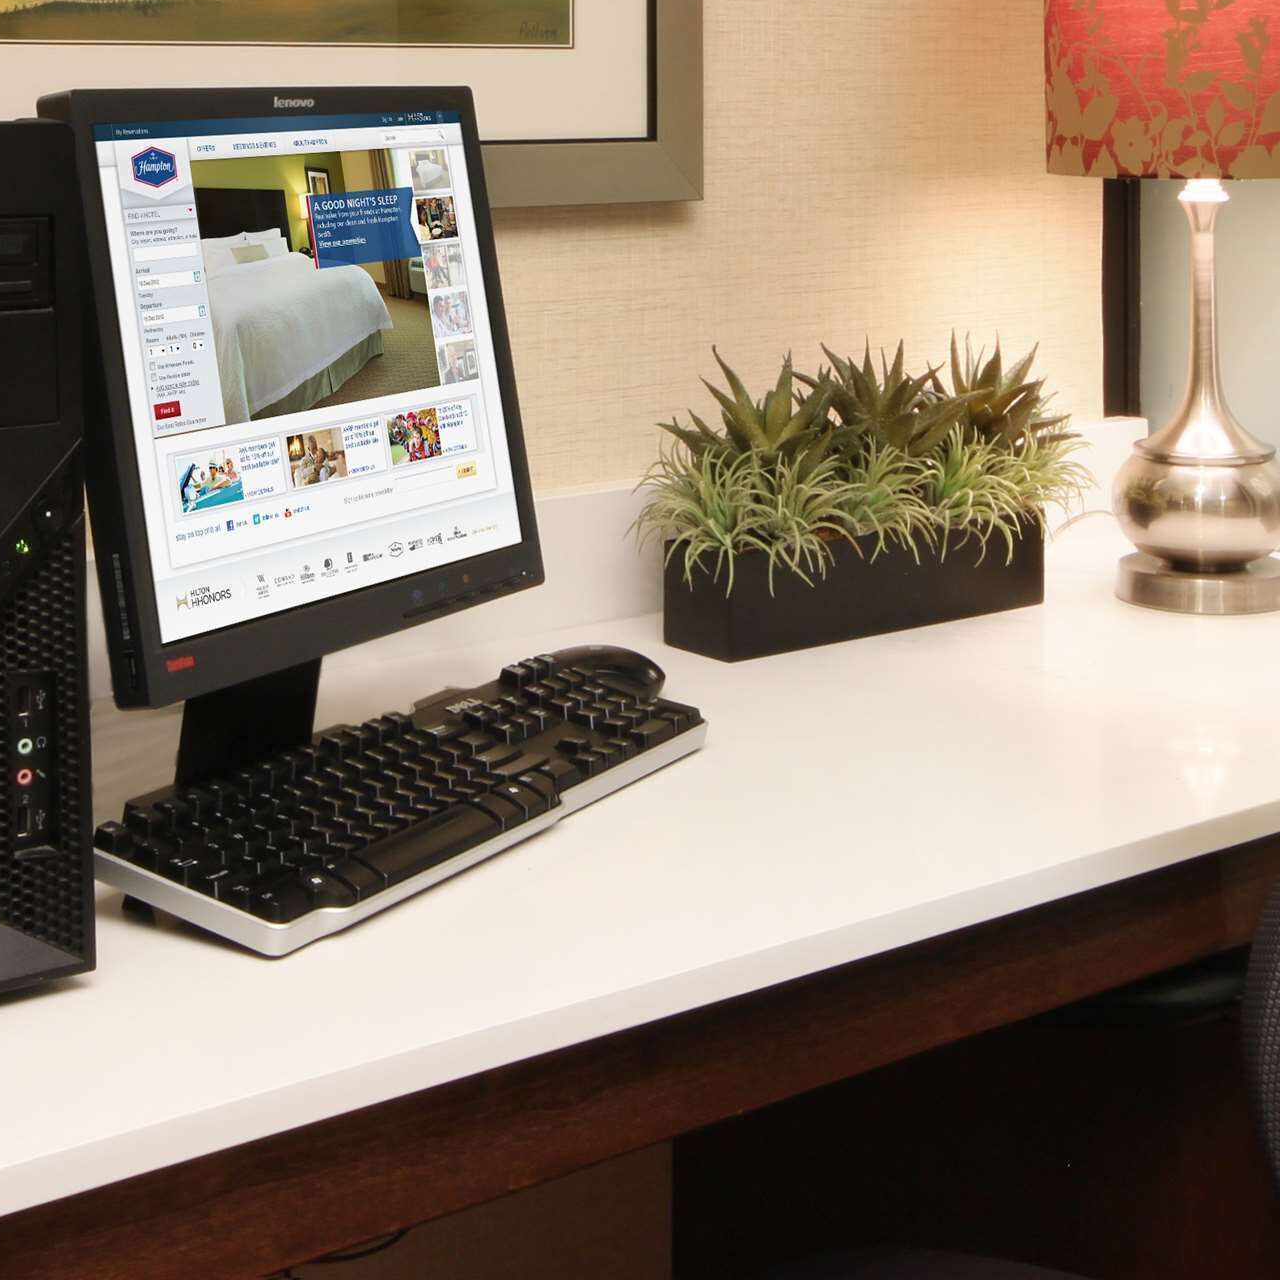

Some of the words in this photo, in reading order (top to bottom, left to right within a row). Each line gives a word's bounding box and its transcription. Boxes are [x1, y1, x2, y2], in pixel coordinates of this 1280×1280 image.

[274, 96, 315, 109] lenovo
[136, 160, 174, 176] Hampton
[314, 201, 321, 211] A
[321, 199, 345, 210] GOOD
[346, 196, 376, 209] NIGHT'S
[377, 194, 398, 205] SLEEP
[190, 586, 210, 597] HILTON
[191, 588, 231, 608] HHONORS
